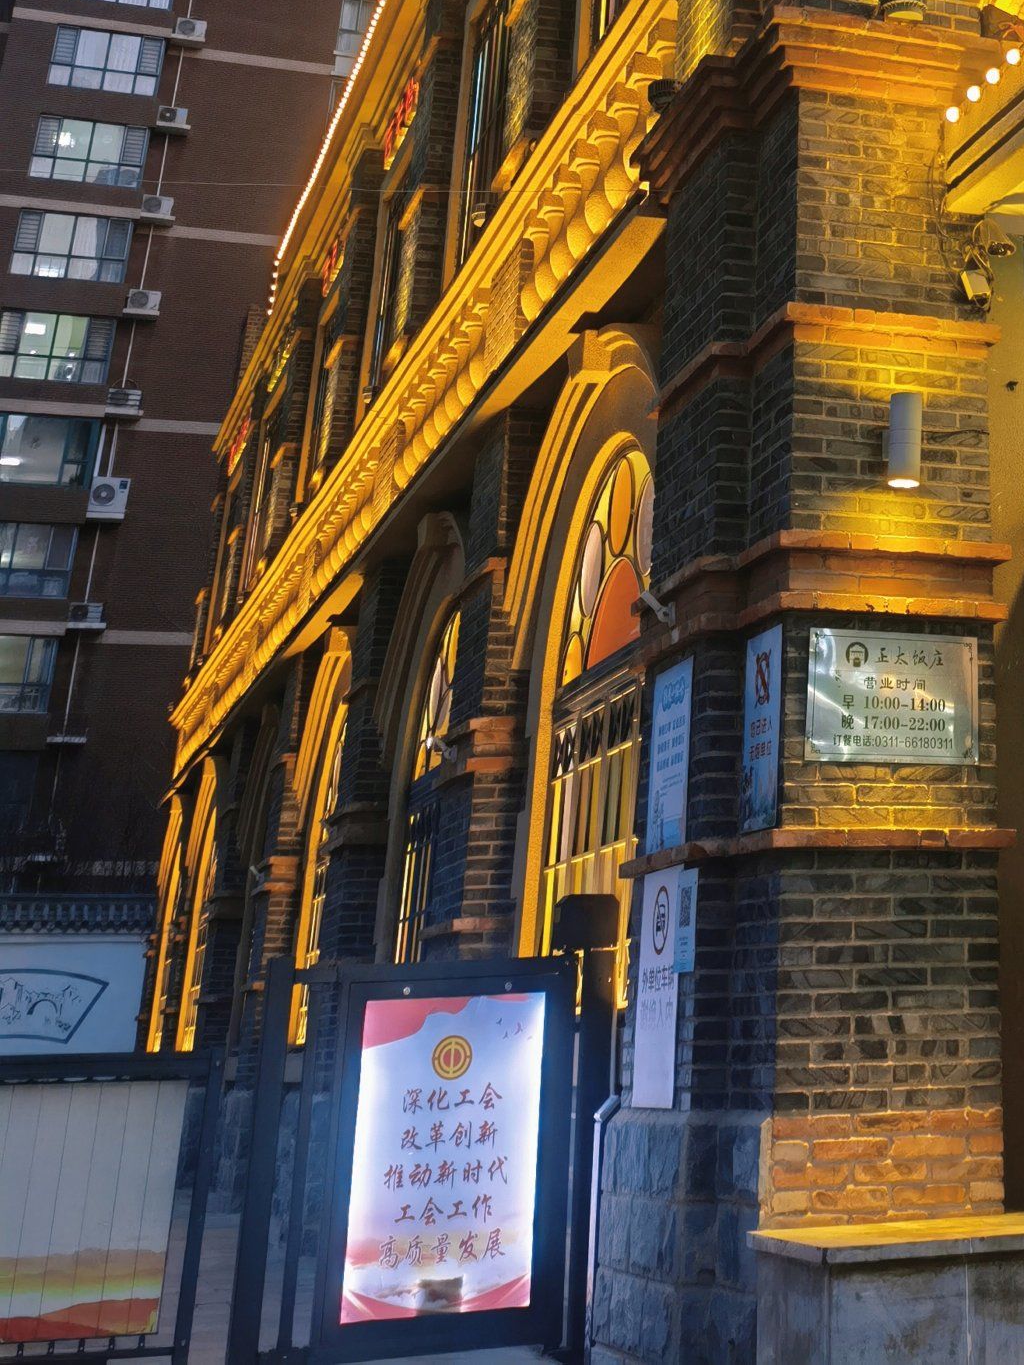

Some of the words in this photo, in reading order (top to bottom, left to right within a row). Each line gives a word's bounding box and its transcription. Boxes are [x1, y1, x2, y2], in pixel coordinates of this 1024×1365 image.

[875, 646, 945, 669] 正太饭庄
[864, 676, 927, 692] 营业时间
[842, 695, 854, 710] 早
[863, 696, 946, 712] 10:00-14:00
[841, 715, 854, 730] 晚
[863, 715, 946, 731] 17:00-22:00
[402, 1082, 503, 1115] 深化工会
[400, 1120, 498, 1154] 改革创新
[383, 1156, 509, 1192] 推动新时代
[394, 1193, 493, 1227] 工会工作
[378, 1228, 506, 1271] 高质量发展
